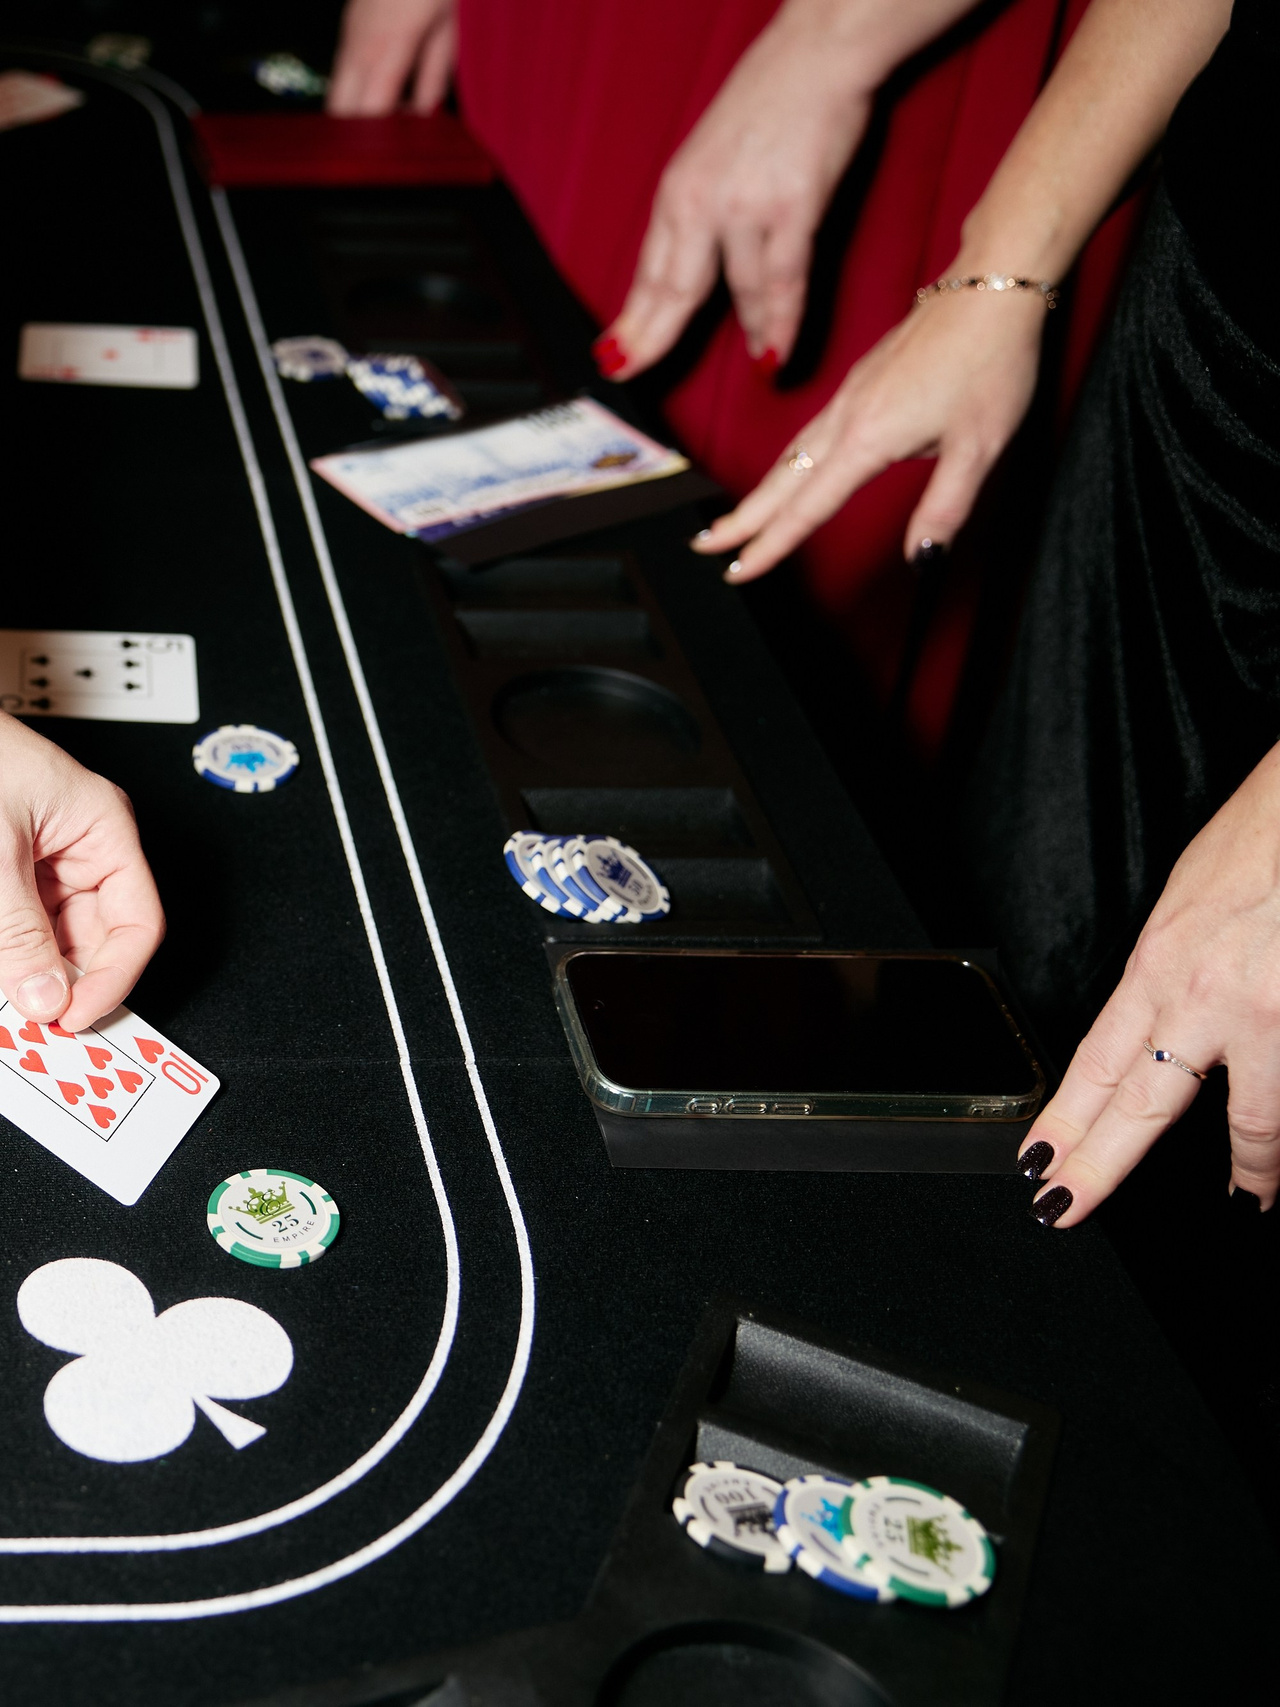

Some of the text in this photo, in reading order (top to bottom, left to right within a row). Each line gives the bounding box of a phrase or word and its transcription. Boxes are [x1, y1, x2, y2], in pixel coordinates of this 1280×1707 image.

[161, 1051, 209, 1095] 10
[271, 1214, 300, 1233] 25
[272, 1219, 315, 1243] EMPIRE
[713, 1486, 757, 1504] 100
[883, 1516, 904, 1544] 25
